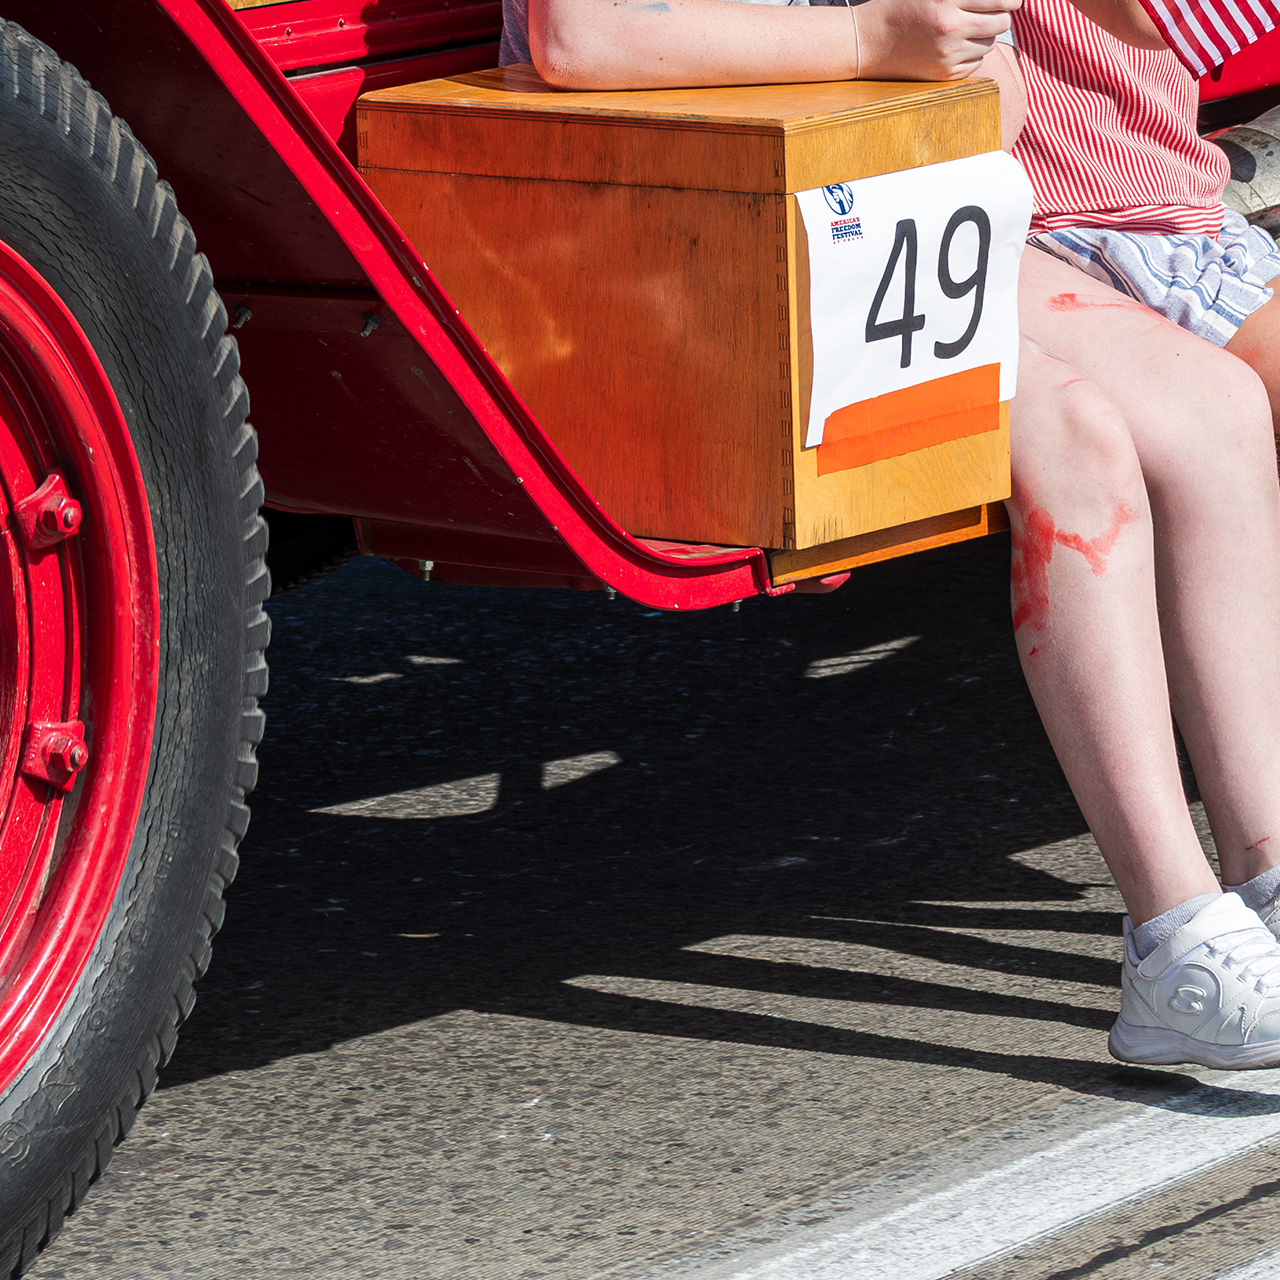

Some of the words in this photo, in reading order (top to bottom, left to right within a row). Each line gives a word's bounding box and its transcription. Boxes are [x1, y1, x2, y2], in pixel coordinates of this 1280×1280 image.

[831, 223, 862, 233] FREEDOM
[832, 229, 863, 240] FESTIVAL
[865, 205, 991, 368] 49
